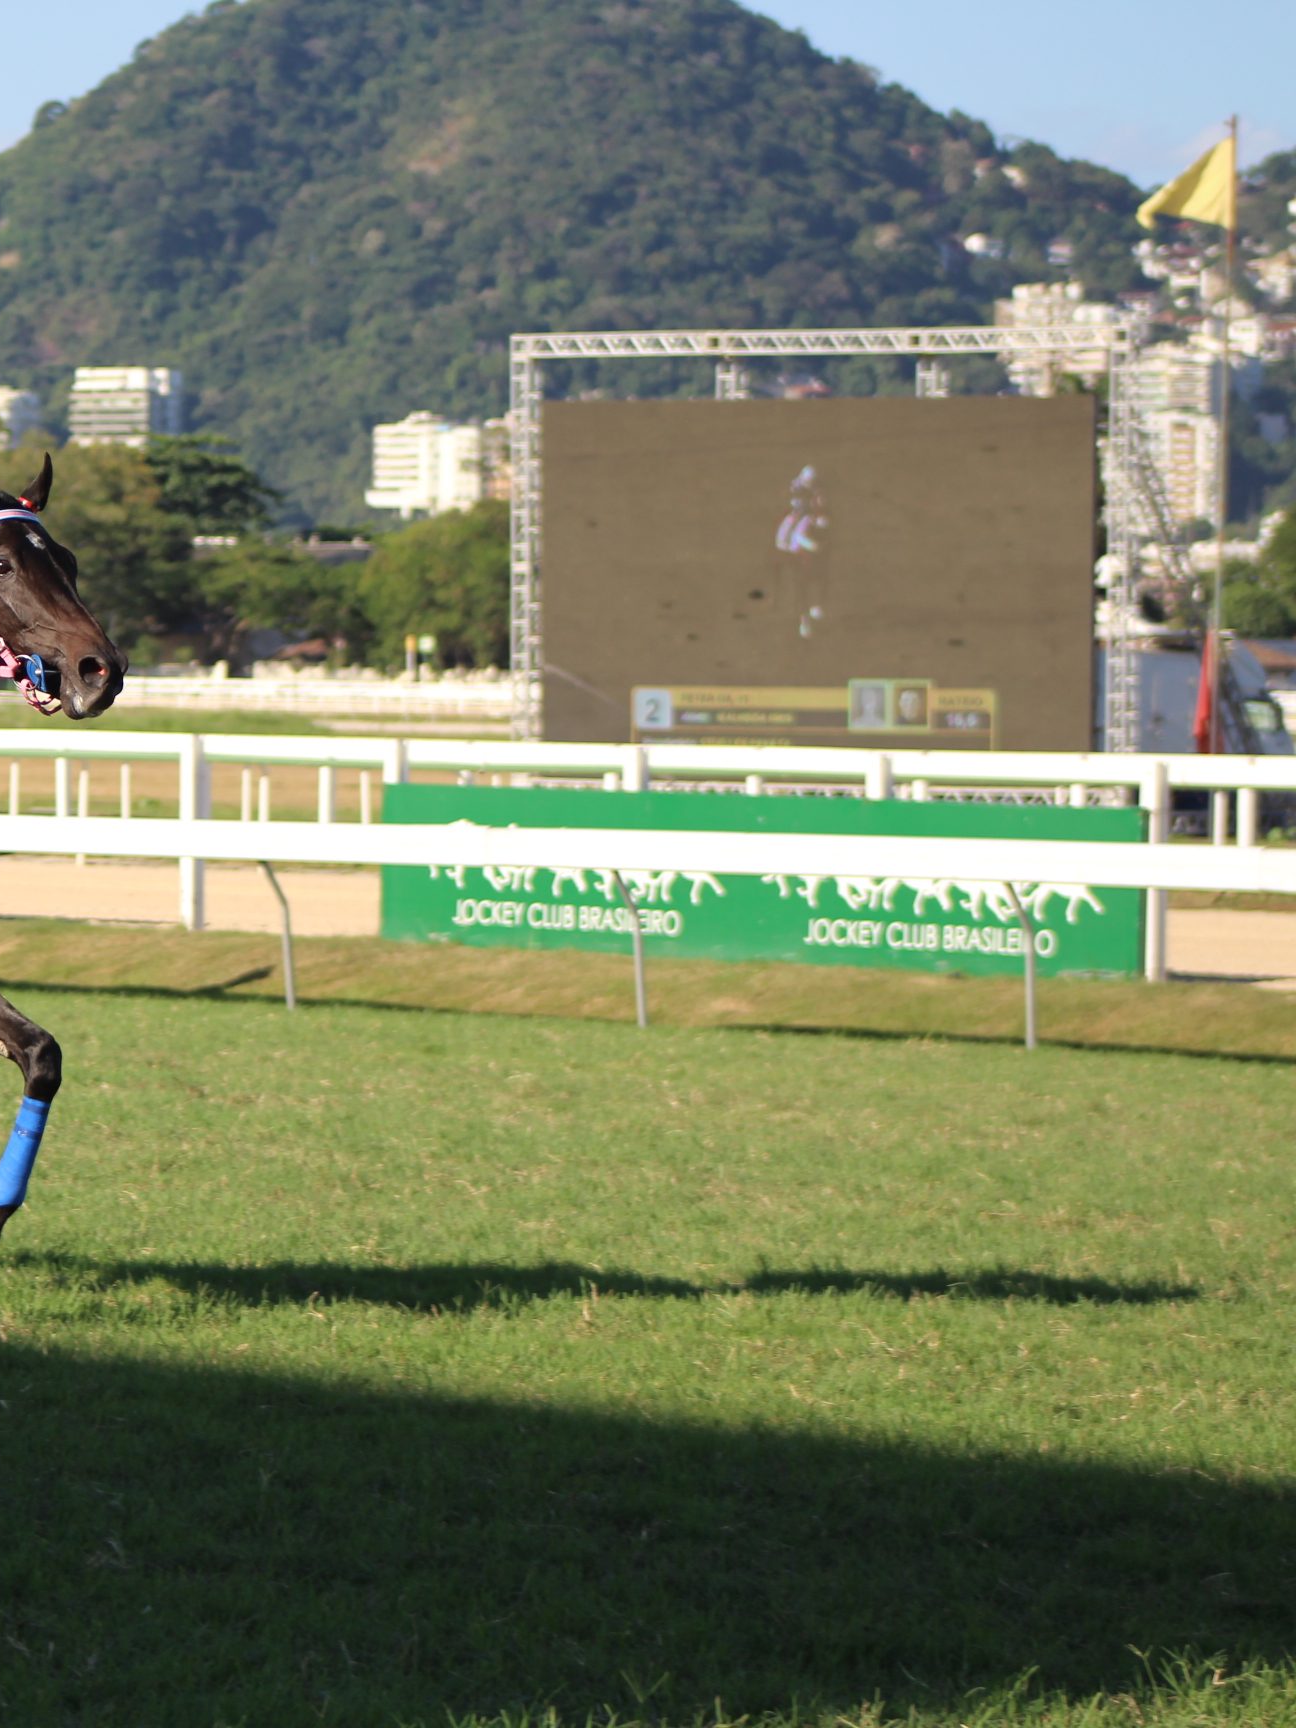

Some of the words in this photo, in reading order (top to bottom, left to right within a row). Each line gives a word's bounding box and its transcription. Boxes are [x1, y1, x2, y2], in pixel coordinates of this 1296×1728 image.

[644, 697, 660, 723] 2
[452, 899, 525, 925] JOCKEY
[526, 902, 576, 930] CLUB
[803, 917, 883, 947] JOCKEY
[885, 921, 940, 950] CLUB
[941, 923, 1058, 958] BRASILEIO
